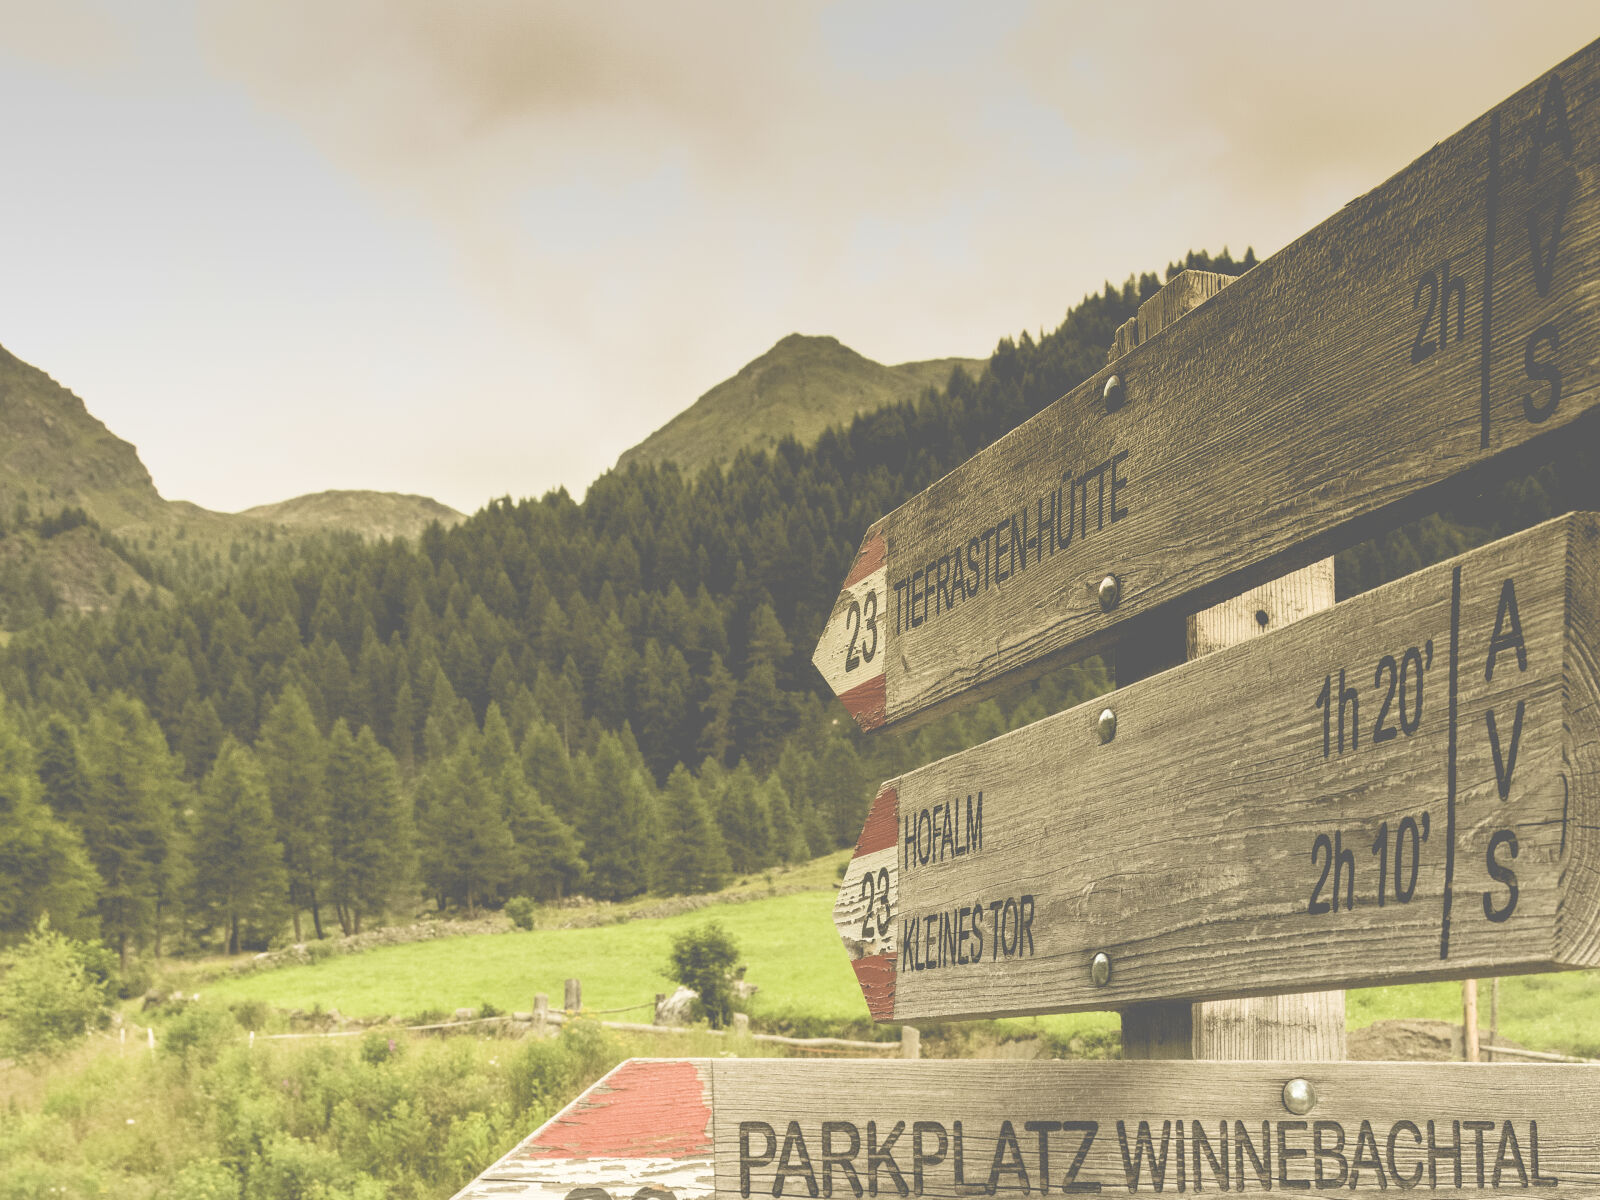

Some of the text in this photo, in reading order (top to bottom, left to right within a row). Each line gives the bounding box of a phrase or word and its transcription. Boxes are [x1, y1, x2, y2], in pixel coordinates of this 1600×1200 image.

[1411, 259, 1466, 365] 2h
[893, 450, 1129, 636] TIEFRASTEN-HÜTTE
[845, 591, 878, 673] 23
[1316, 640, 1433, 758] 1h 20'
[1483, 578, 1527, 923] AVS
[904, 791, 983, 871] HOFALM
[1309, 812, 1430, 915] 2h 10'
[861, 867, 891, 938] 23
[902, 894, 1035, 973] KLEINES TOR
[738, 1119, 1558, 1198] PARKPLATZ WINNEBACHTAL
